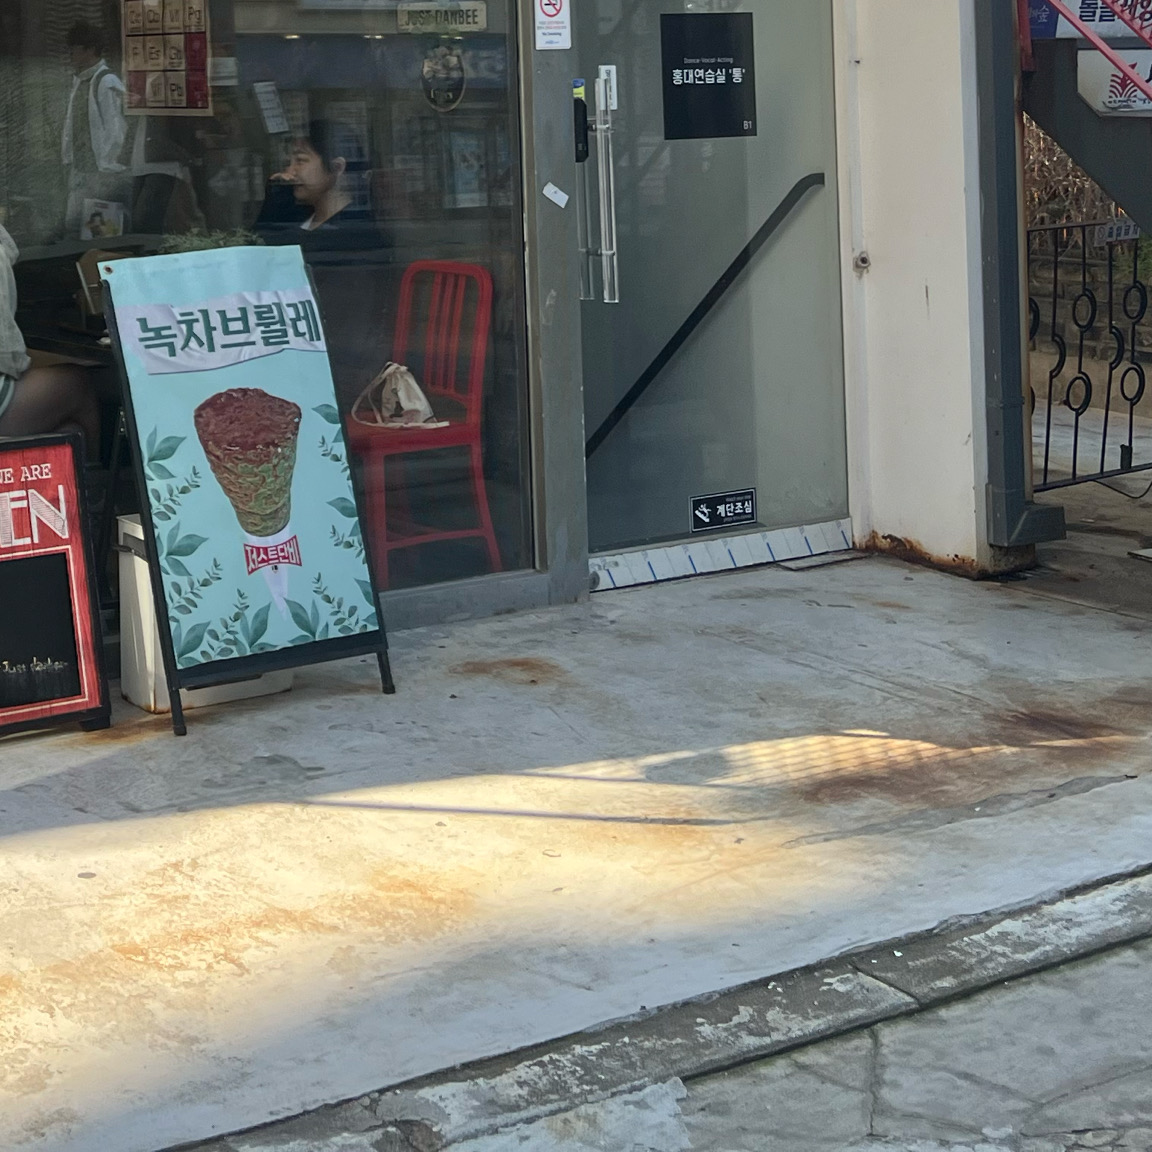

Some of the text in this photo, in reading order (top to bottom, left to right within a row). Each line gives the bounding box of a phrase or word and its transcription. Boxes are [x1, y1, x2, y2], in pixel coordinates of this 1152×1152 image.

[435, 8, 479, 26] DANBEE
[672, 68, 726, 85] 홍대연습실
[136, 299, 322, 358] 녹차브륄레
[20, 463, 53, 482] ARE
[716, 500, 753, 518] 계단조심
[245, 537, 301, 572] 저스트단비
